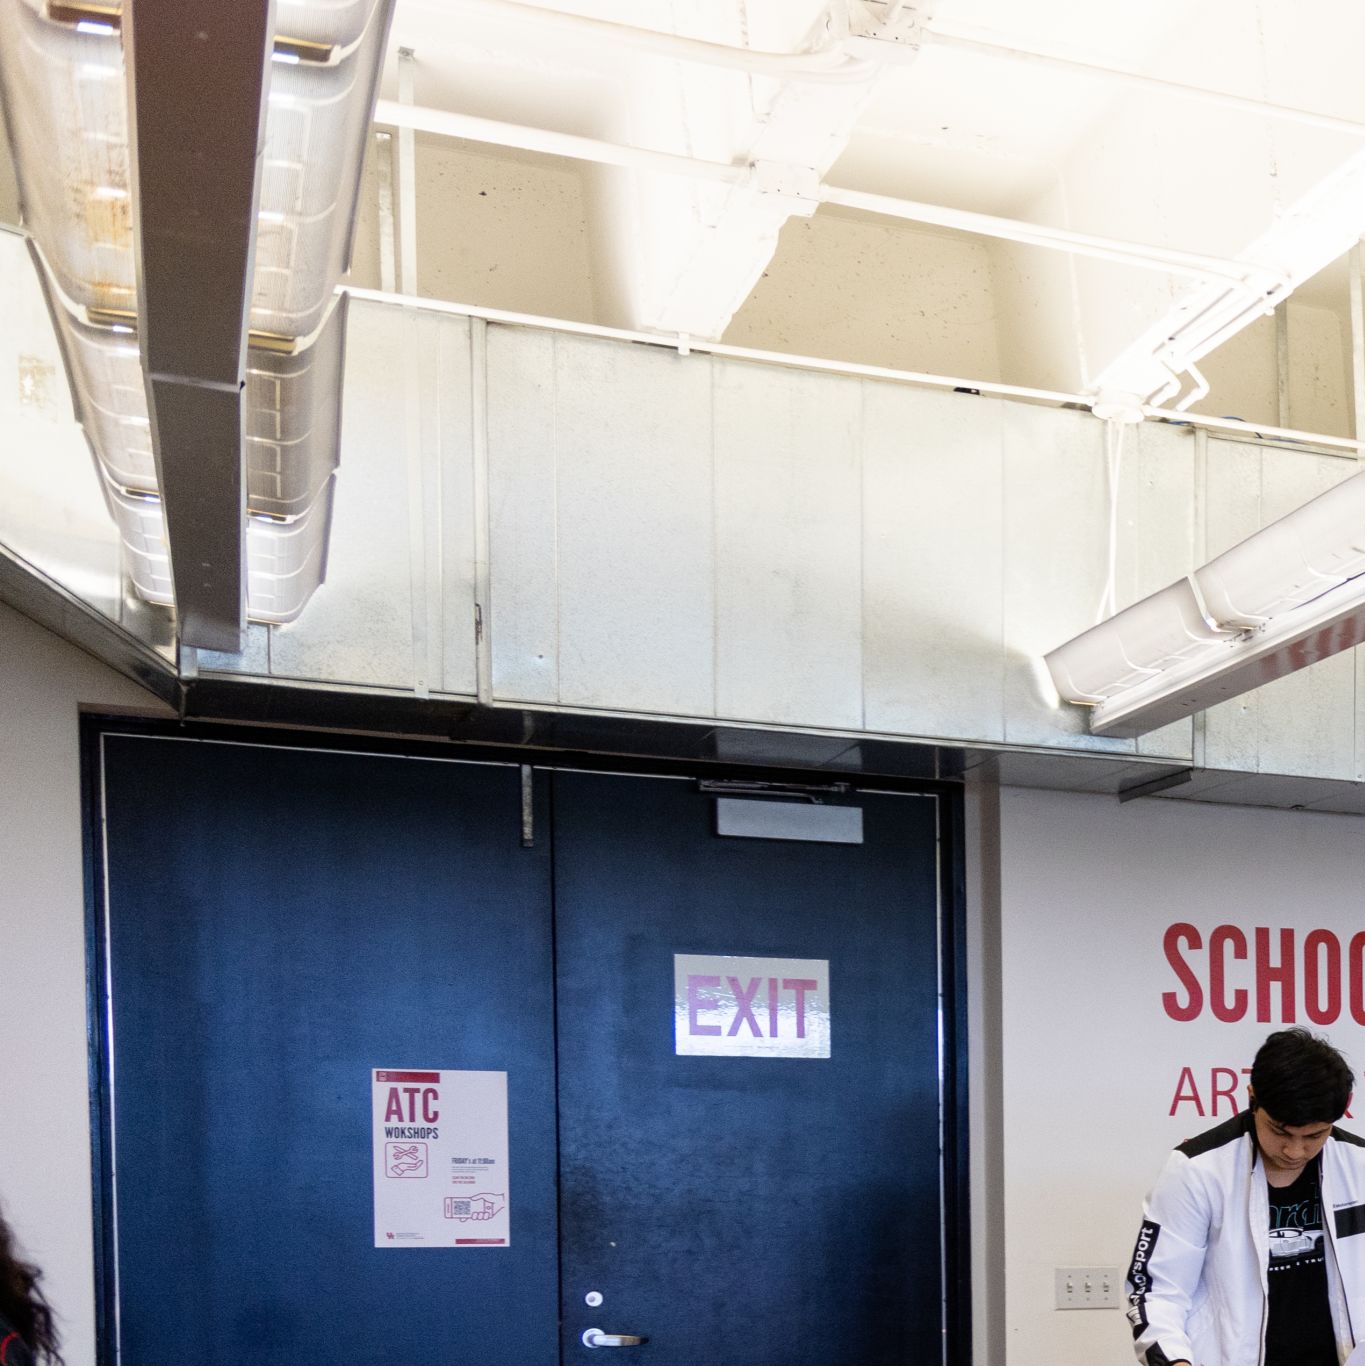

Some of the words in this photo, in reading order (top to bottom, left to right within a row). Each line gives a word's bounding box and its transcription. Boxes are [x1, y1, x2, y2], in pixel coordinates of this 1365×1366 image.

[687, 975, 817, 1038] EXIT
[384, 1086, 439, 1124] ATC
[1168, 1066, 1253, 1117] AR
[384, 1126, 439, 1140] WOKSHOPS
